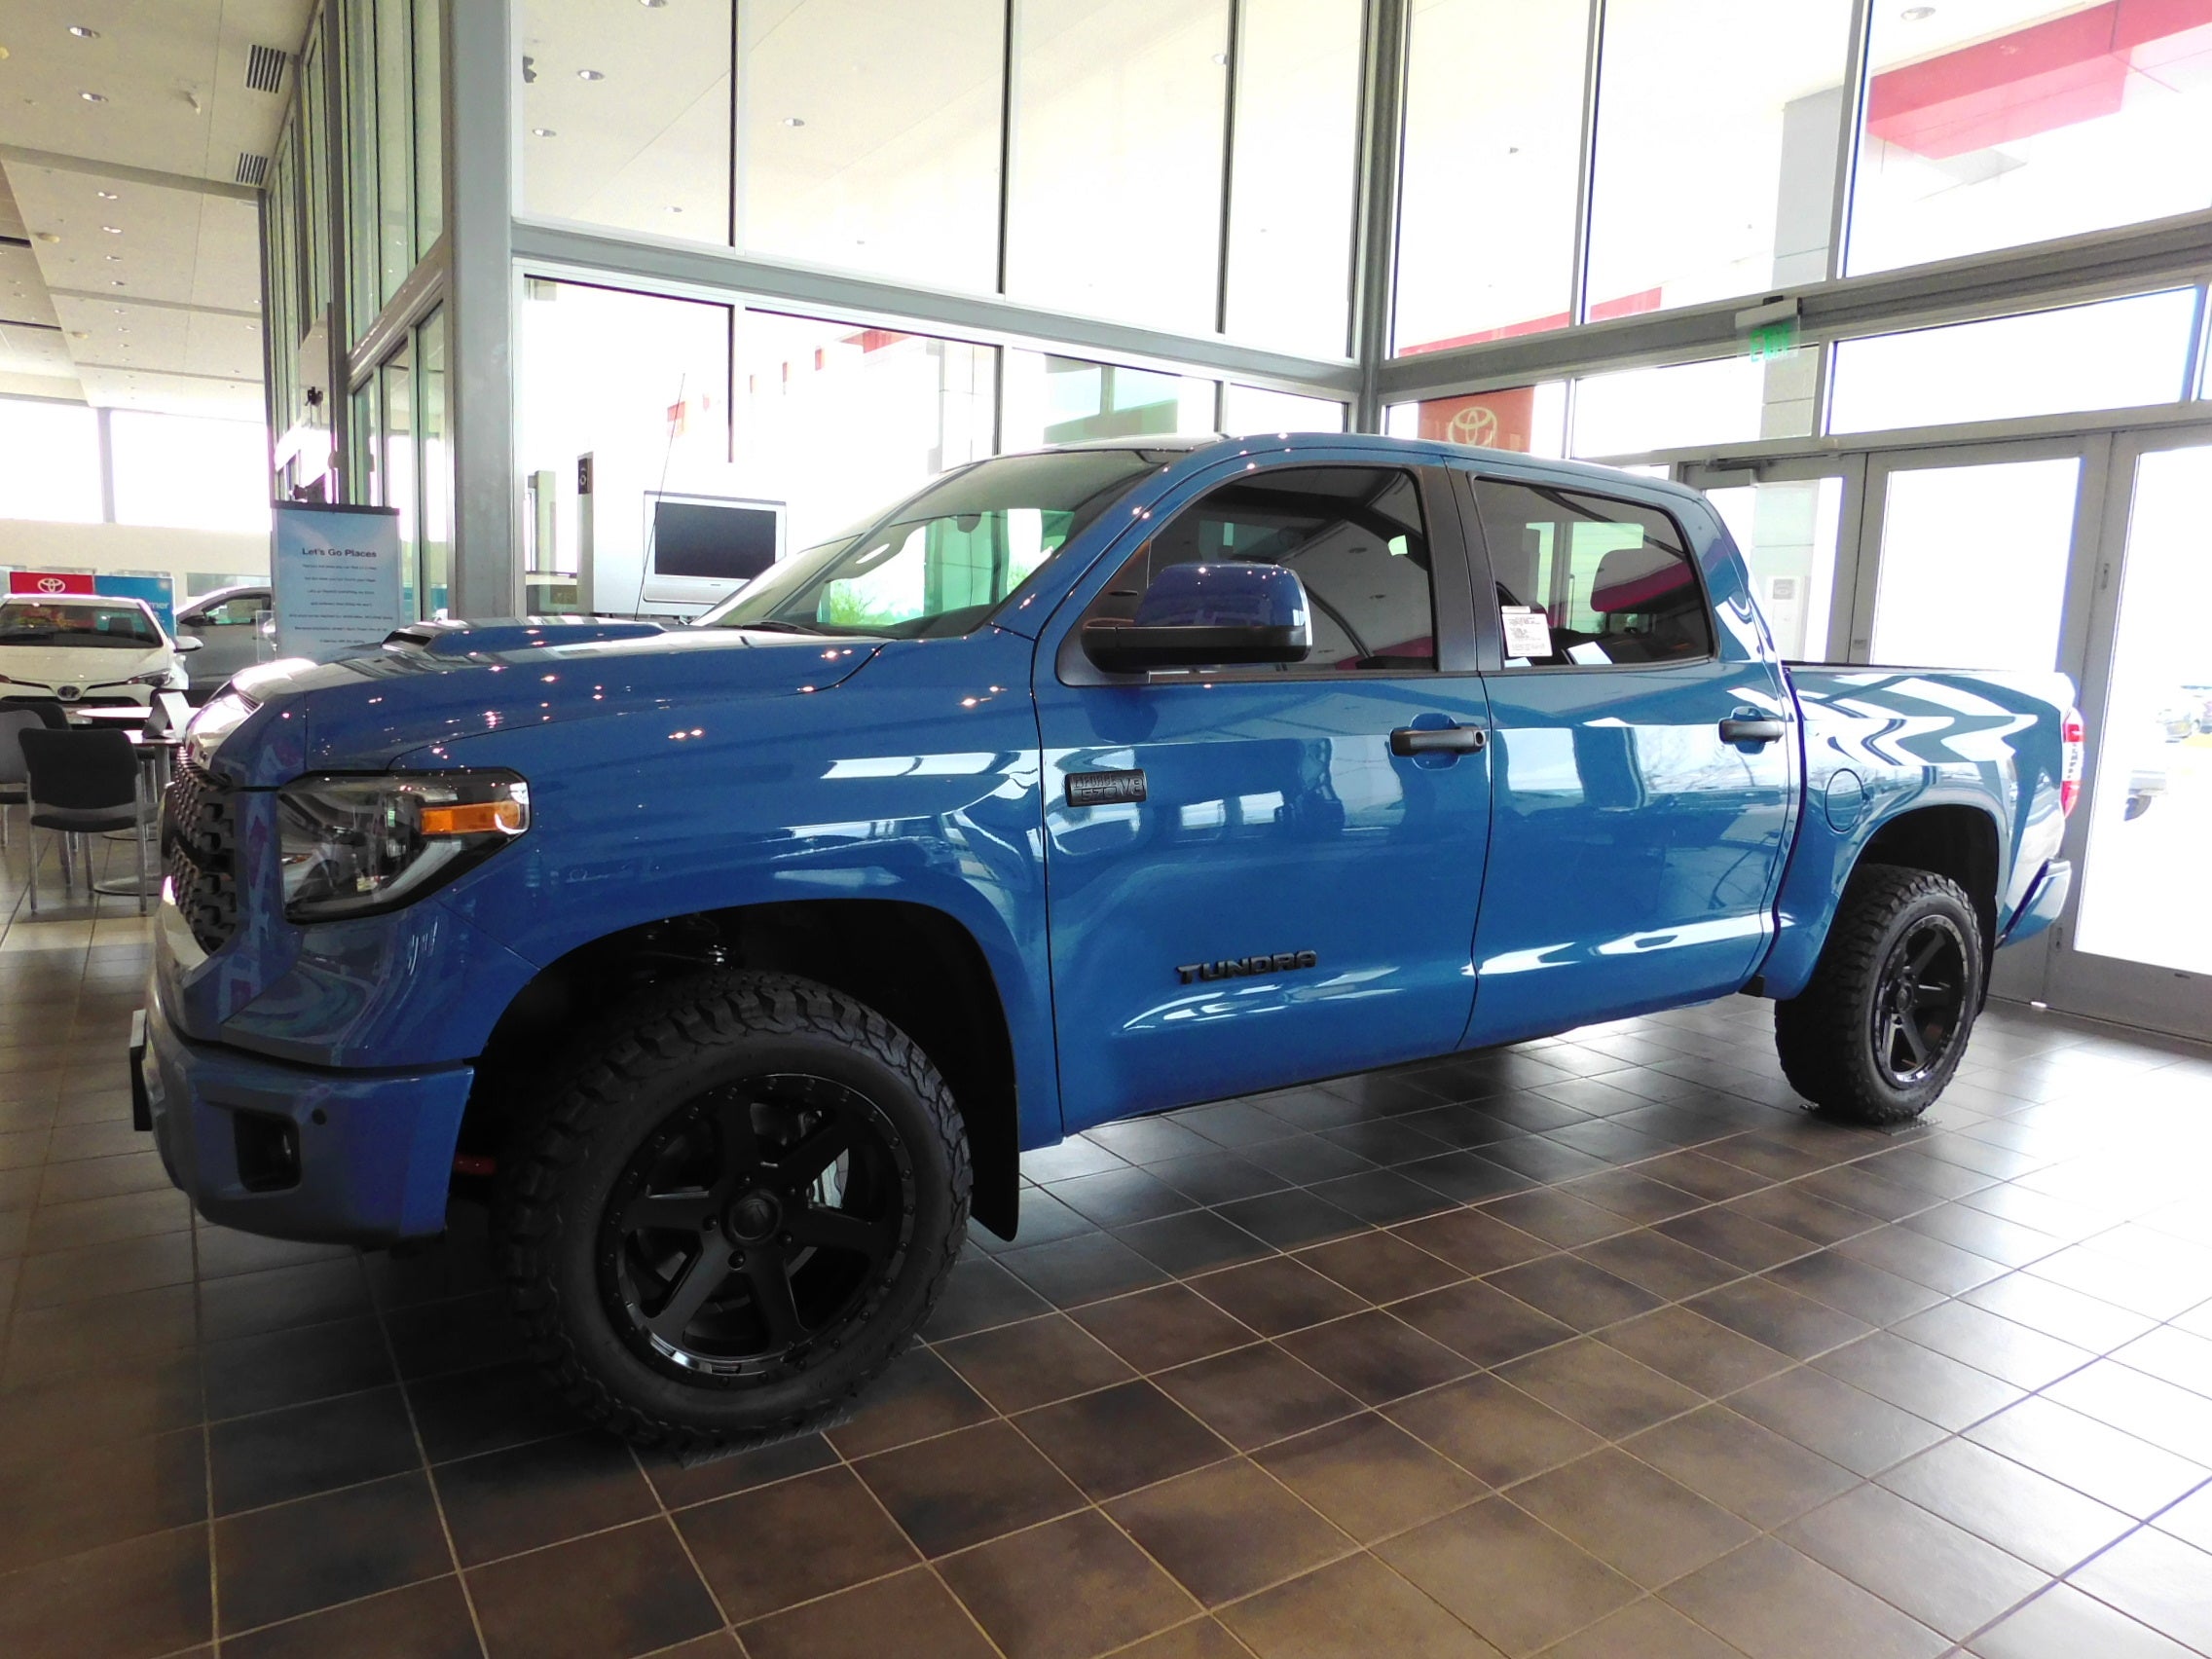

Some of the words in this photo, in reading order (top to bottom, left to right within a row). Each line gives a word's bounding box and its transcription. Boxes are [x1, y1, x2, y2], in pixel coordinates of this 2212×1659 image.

[302, 547, 325, 556] Let's
[328, 548, 343, 557] Go
[345, 549, 377, 558] Places
[1176, 949, 1318, 985] TUNDRA
